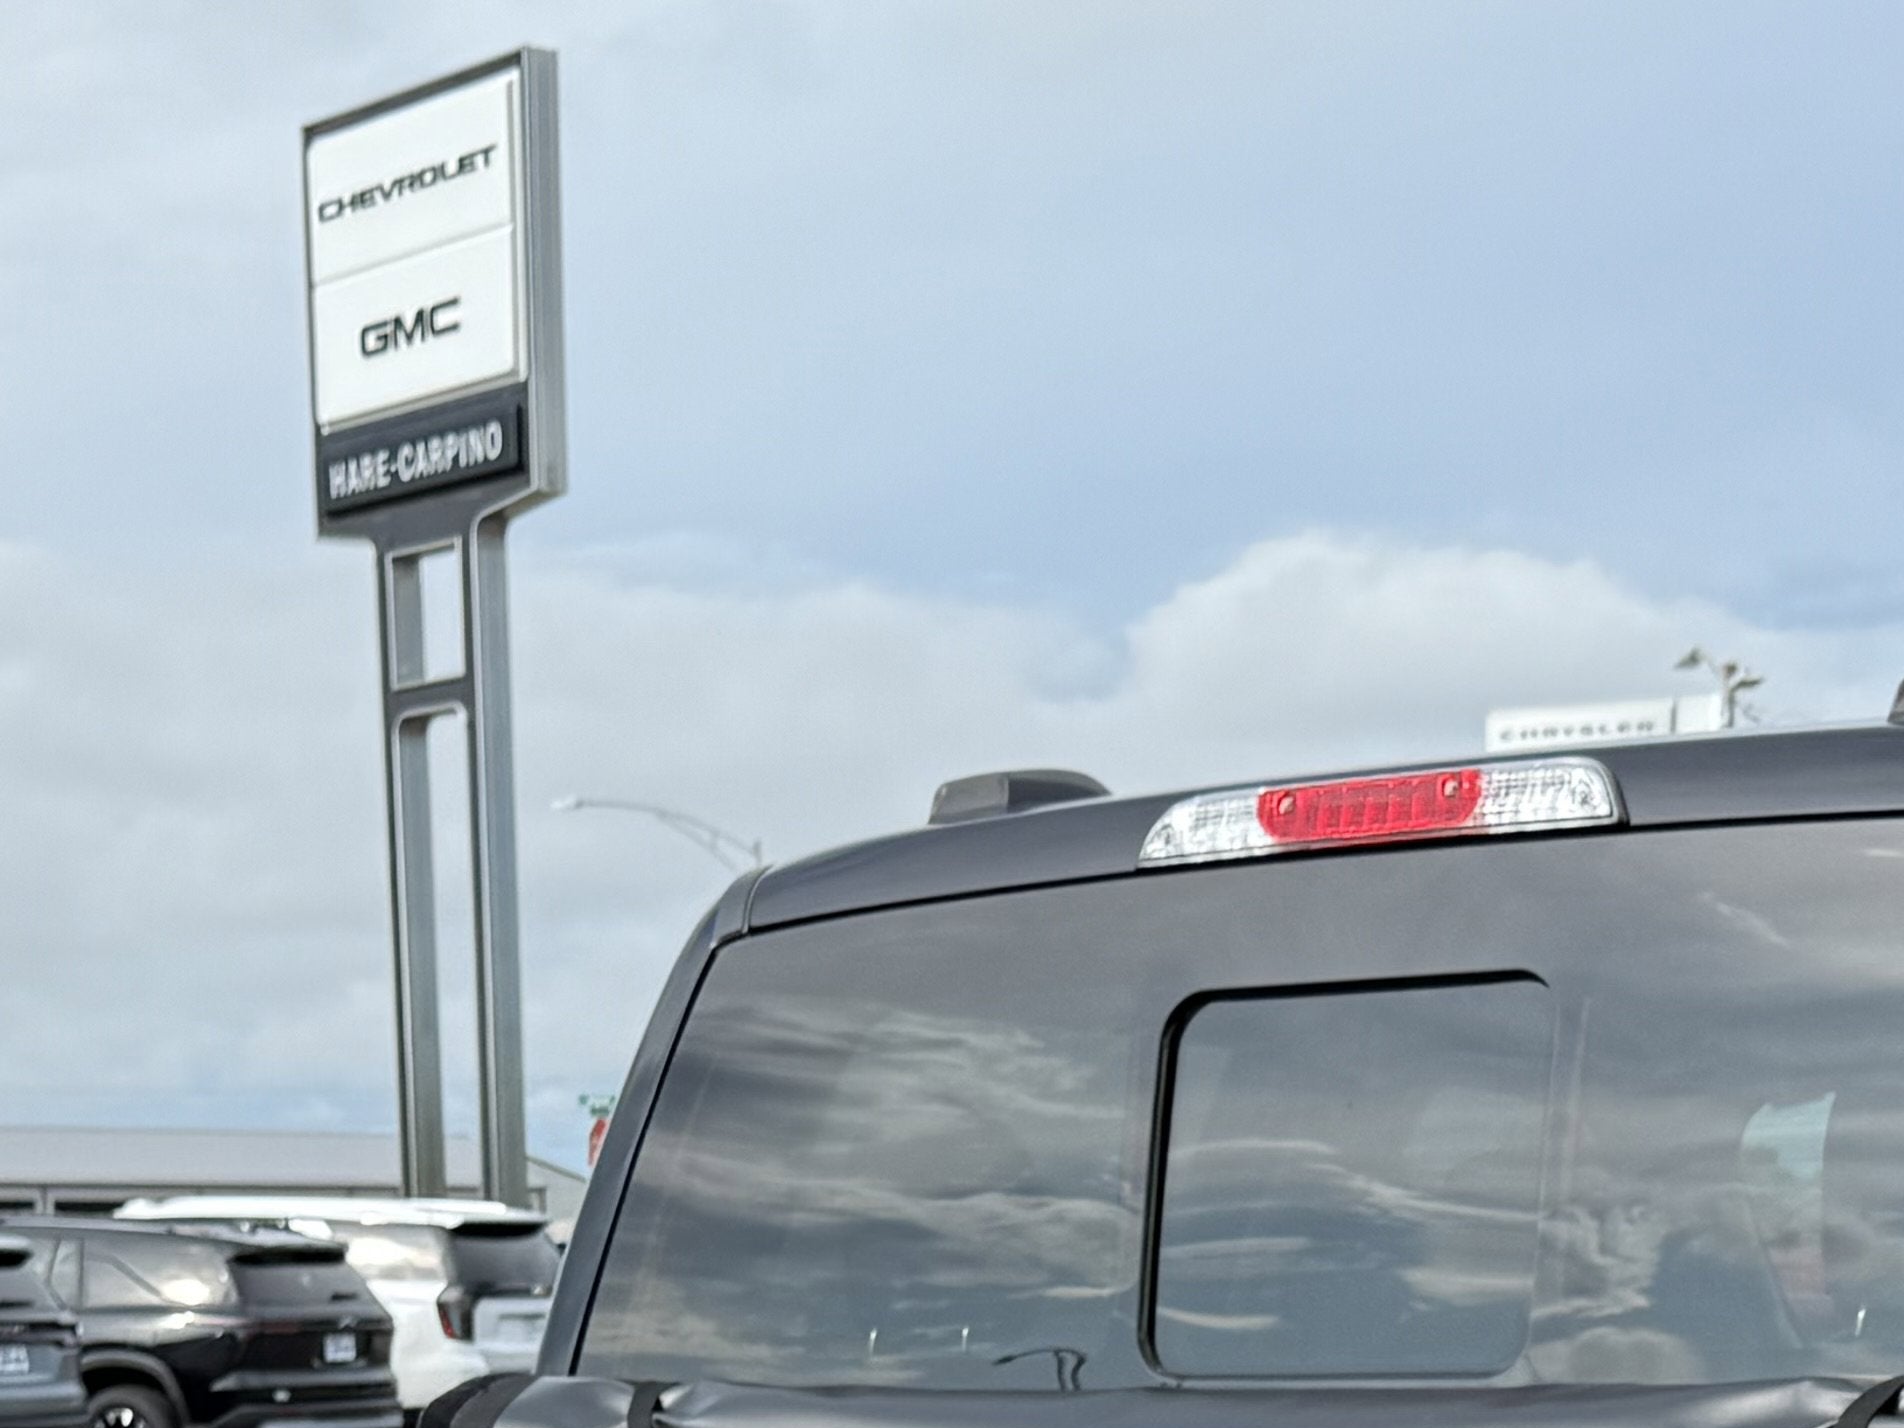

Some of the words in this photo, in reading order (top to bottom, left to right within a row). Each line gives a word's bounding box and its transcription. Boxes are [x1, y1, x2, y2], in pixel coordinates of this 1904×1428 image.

[316, 143, 498, 224] CHEVROLET
[359, 297, 462, 359] GMC
[328, 419, 504, 500] HARE-CARPINO
